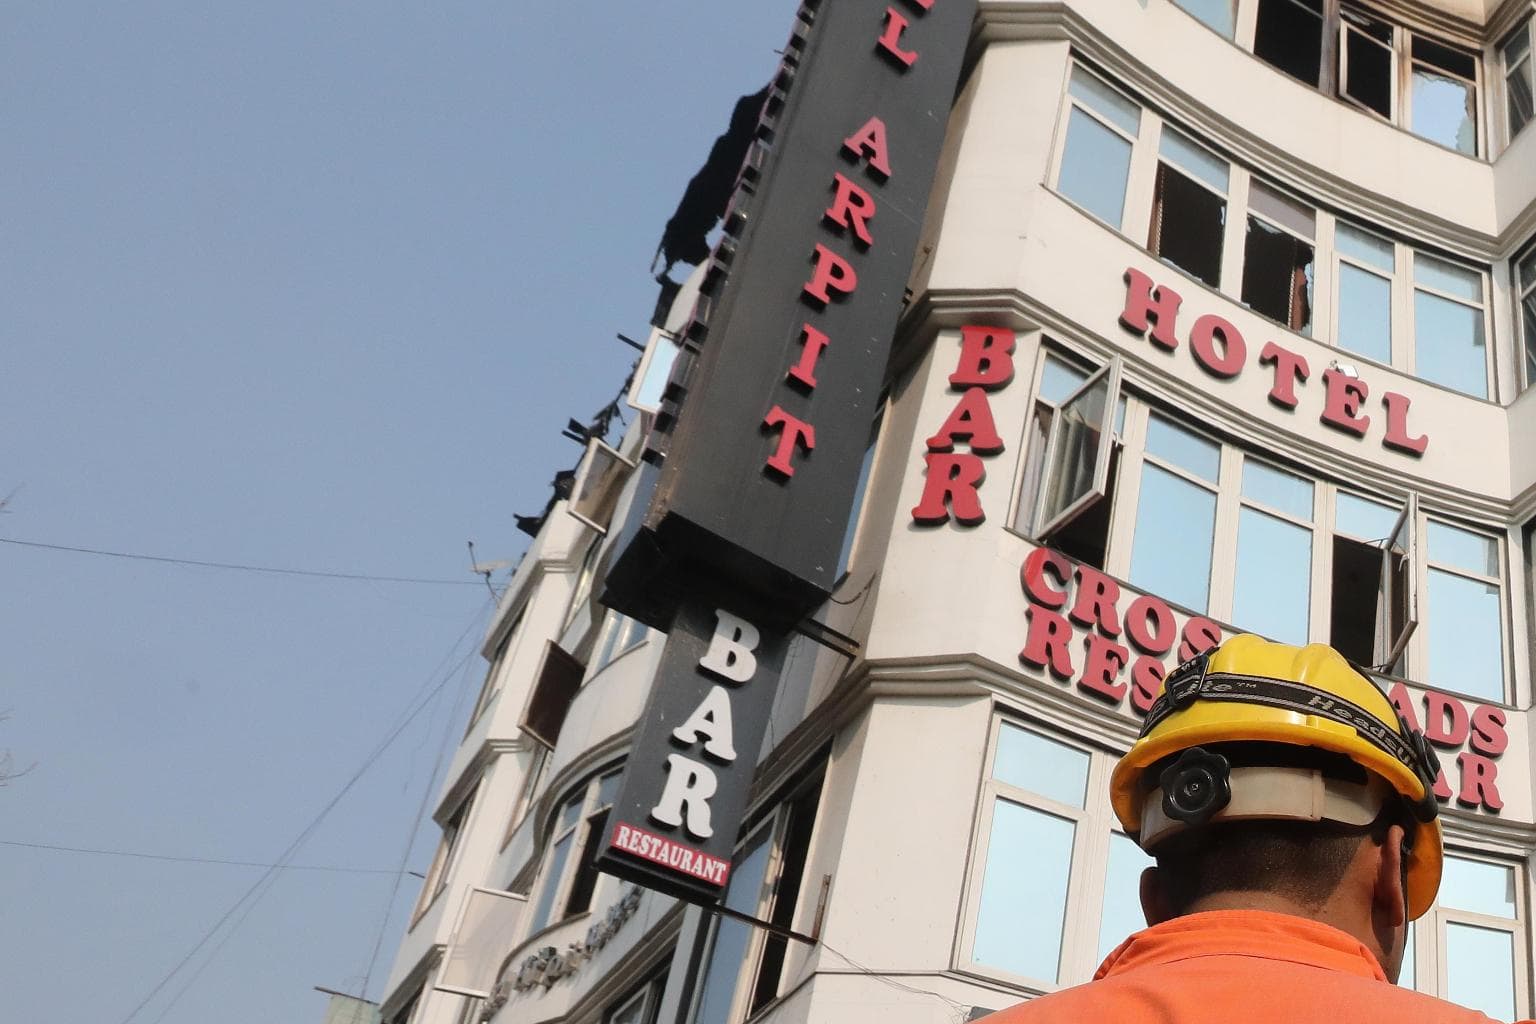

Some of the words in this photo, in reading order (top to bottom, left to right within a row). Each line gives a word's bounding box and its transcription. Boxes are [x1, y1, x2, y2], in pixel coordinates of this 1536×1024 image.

[878, 0, 935, 66] L
[765, 117, 891, 477] ARPIT
[1118, 267, 1429, 456] HOTEL
[911, 325, 1016, 523] BAR
[651, 608, 760, 838] BAR
[615, 825, 727, 882] RESTAURANT
